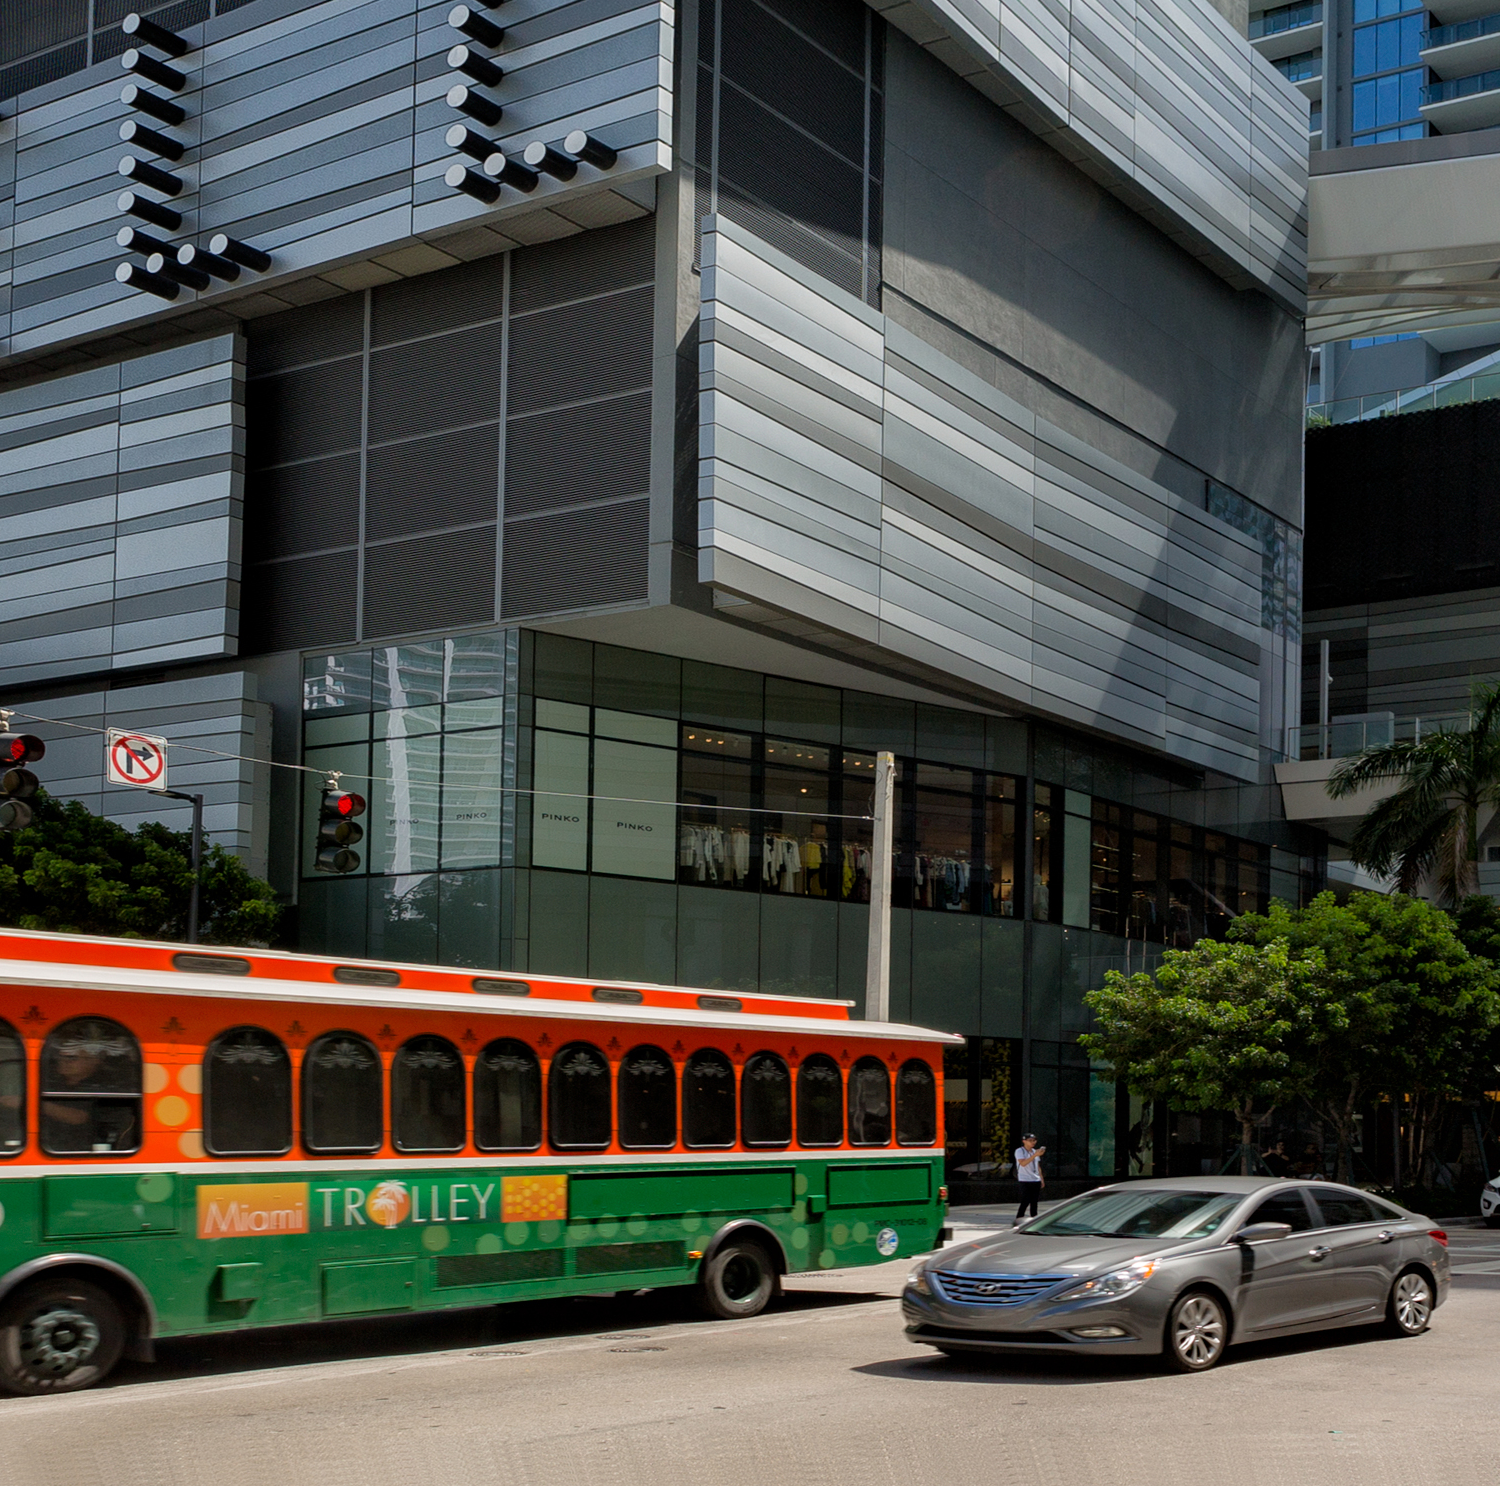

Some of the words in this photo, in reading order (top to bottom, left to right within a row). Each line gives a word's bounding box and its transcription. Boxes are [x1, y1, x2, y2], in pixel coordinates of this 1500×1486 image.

[456, 811, 487, 821] PINKO
[541, 812, 580, 823] PINKO
[616, 821, 653, 832] PINKO
[203, 1200, 304, 1234] Miami
[314, 1180, 496, 1230] TROLLEY
